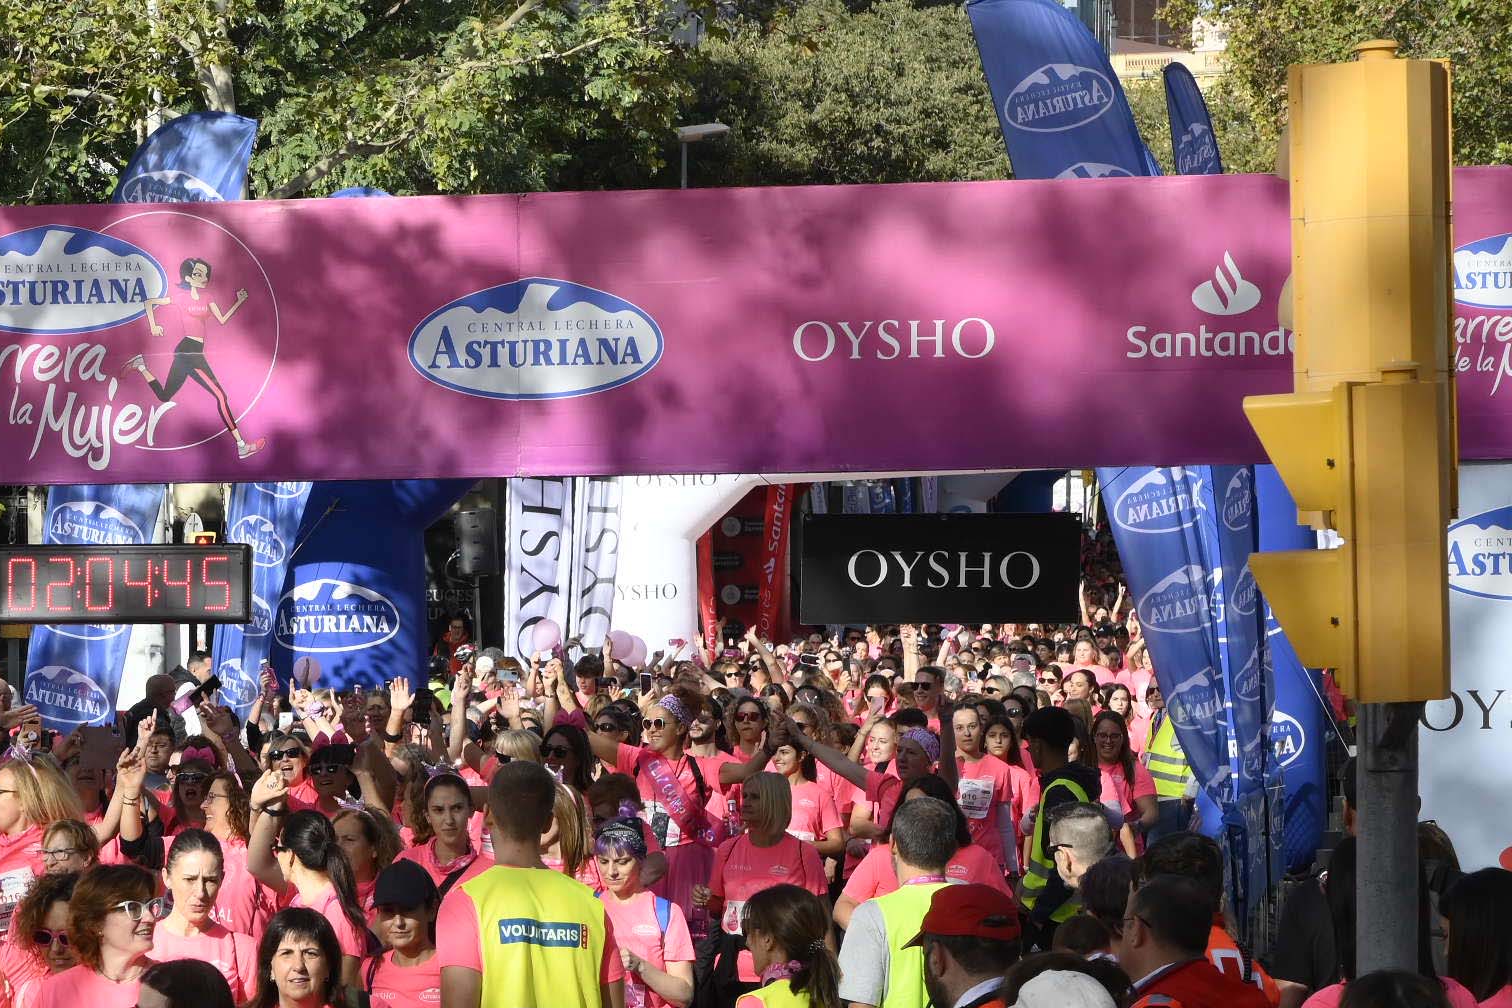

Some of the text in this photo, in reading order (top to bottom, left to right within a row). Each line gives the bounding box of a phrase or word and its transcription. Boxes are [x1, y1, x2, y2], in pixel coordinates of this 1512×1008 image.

[70, 261, 144, 273] LECHERA
[466, 319, 635, 334] CENTRAL LECHERA
[792, 317, 996, 362] OYSHO
[427, 326, 644, 370] ASTURIANA
[1476, 344, 1494, 372] la
[8, 386, 33, 425] la
[29, 378, 177, 472] Mujer
[7, 555, 231, 612] 02:04:45
[517, 477, 565, 669] OYSH
[848, 549, 1041, 590] OYSHO
[616, 582, 678, 601] YSHO
[277, 608, 390, 636] ASTURIANA
[1420, 689, 1512, 732] OY
